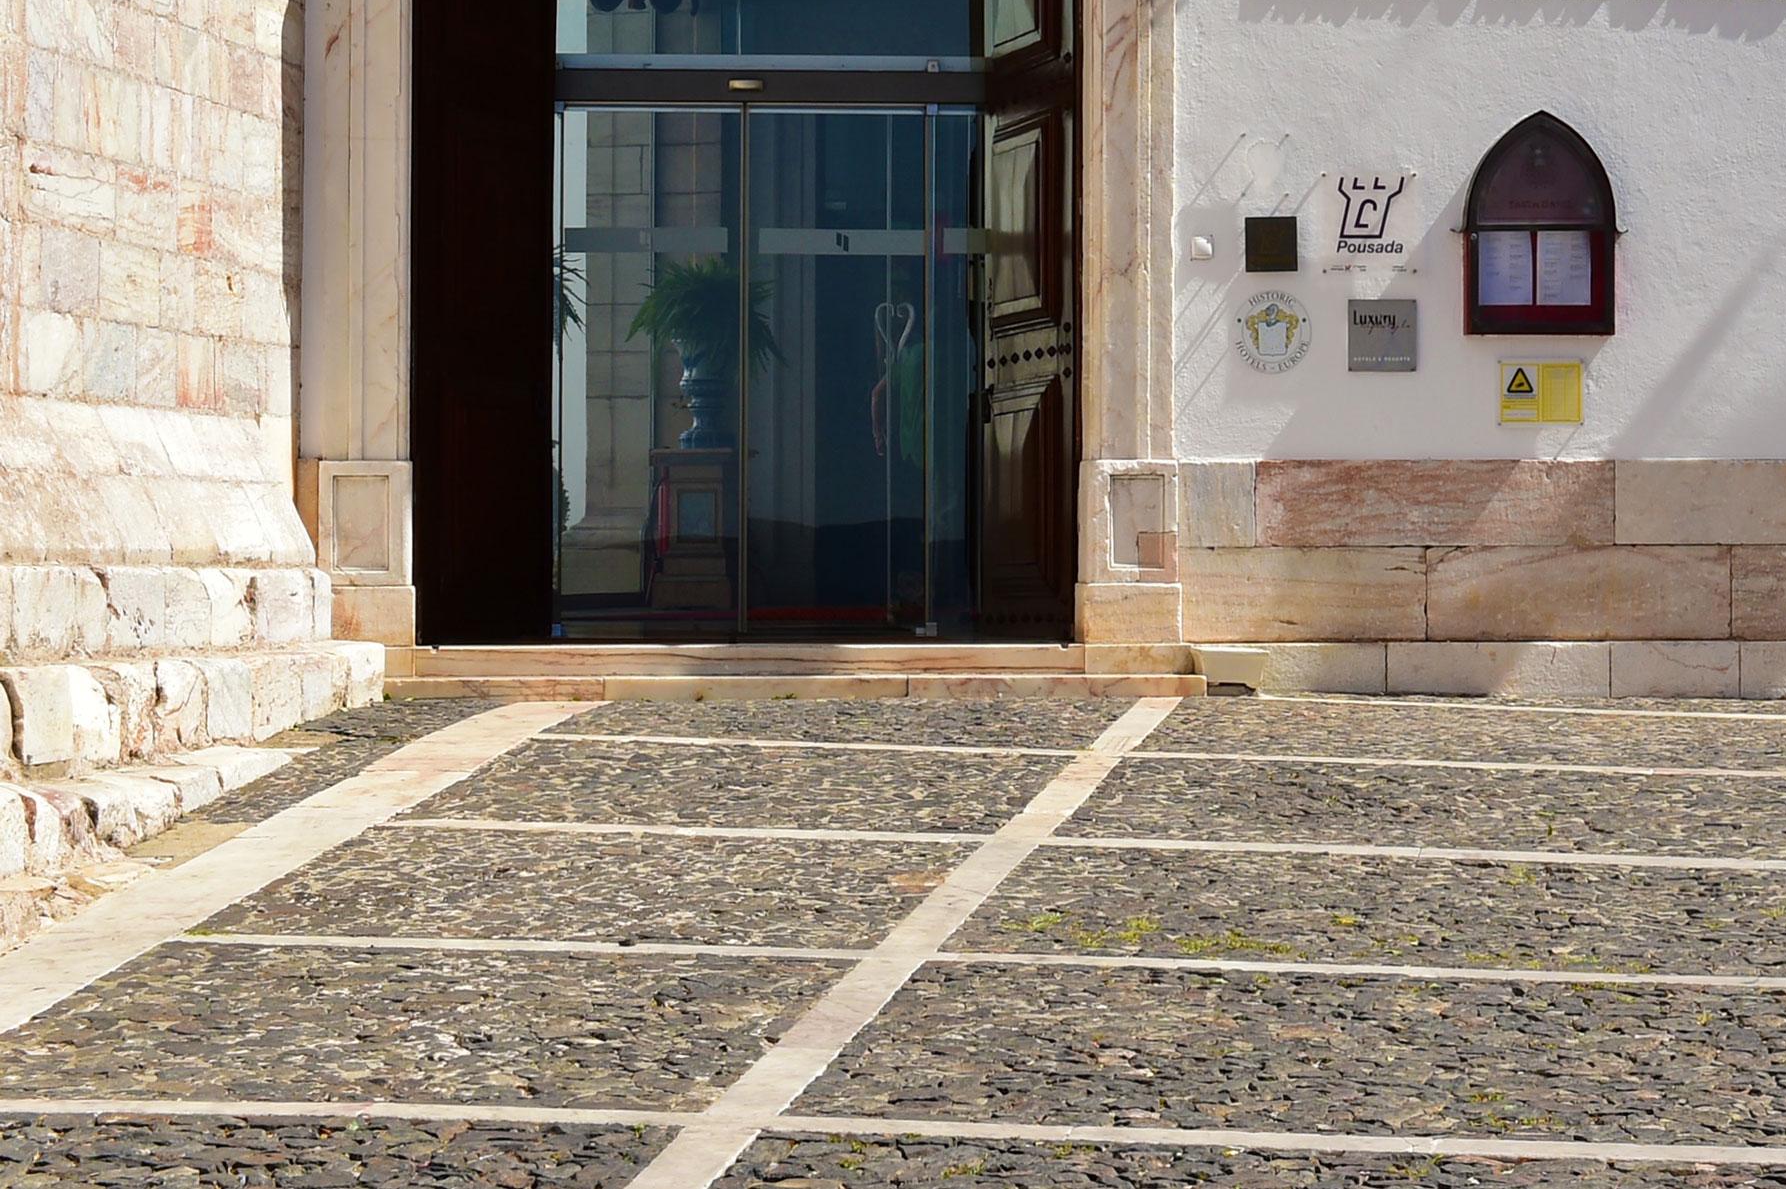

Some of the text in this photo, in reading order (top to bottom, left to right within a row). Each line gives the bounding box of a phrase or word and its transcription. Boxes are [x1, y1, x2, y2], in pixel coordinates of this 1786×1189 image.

[1336, 240, 1404, 253] Pousada
[1248, 292, 1294, 307] HISTORIC
[1353, 309, 1396, 329] Luxury
